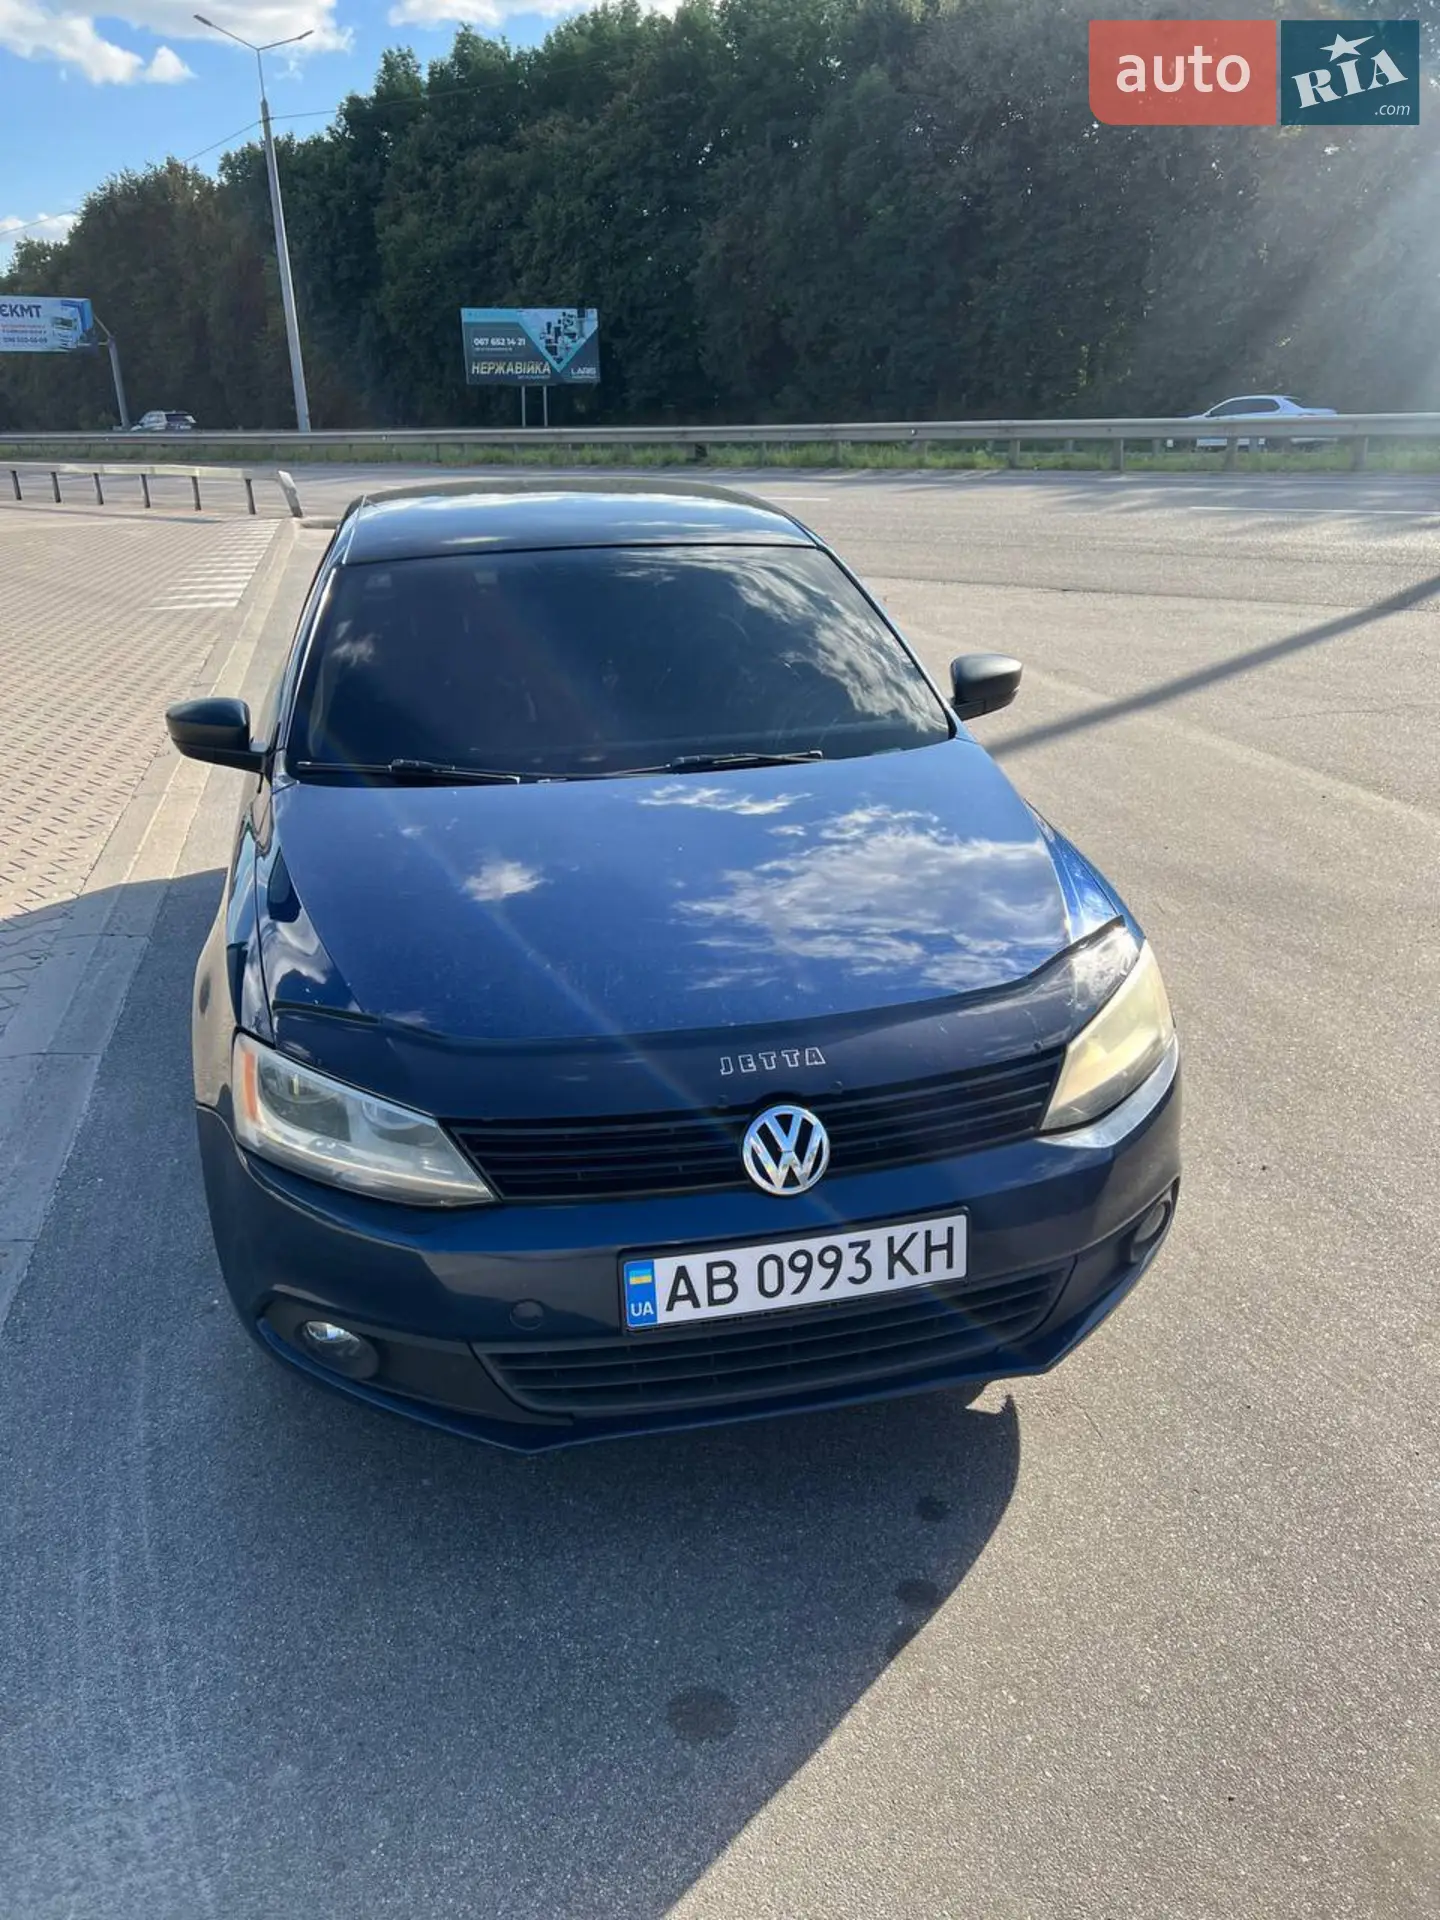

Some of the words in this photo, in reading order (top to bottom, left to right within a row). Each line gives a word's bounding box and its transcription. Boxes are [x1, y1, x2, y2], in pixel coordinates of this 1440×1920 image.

[471, 360, 551, 375] НЕРЖАВІЙКА
[719, 1047, 826, 1076] JETTA
[665, 1259, 739, 1312] AB
[757, 1240, 872, 1298] 0993
[887, 1226, 954, 1280] KH
[631, 1302, 654, 1317] UA
